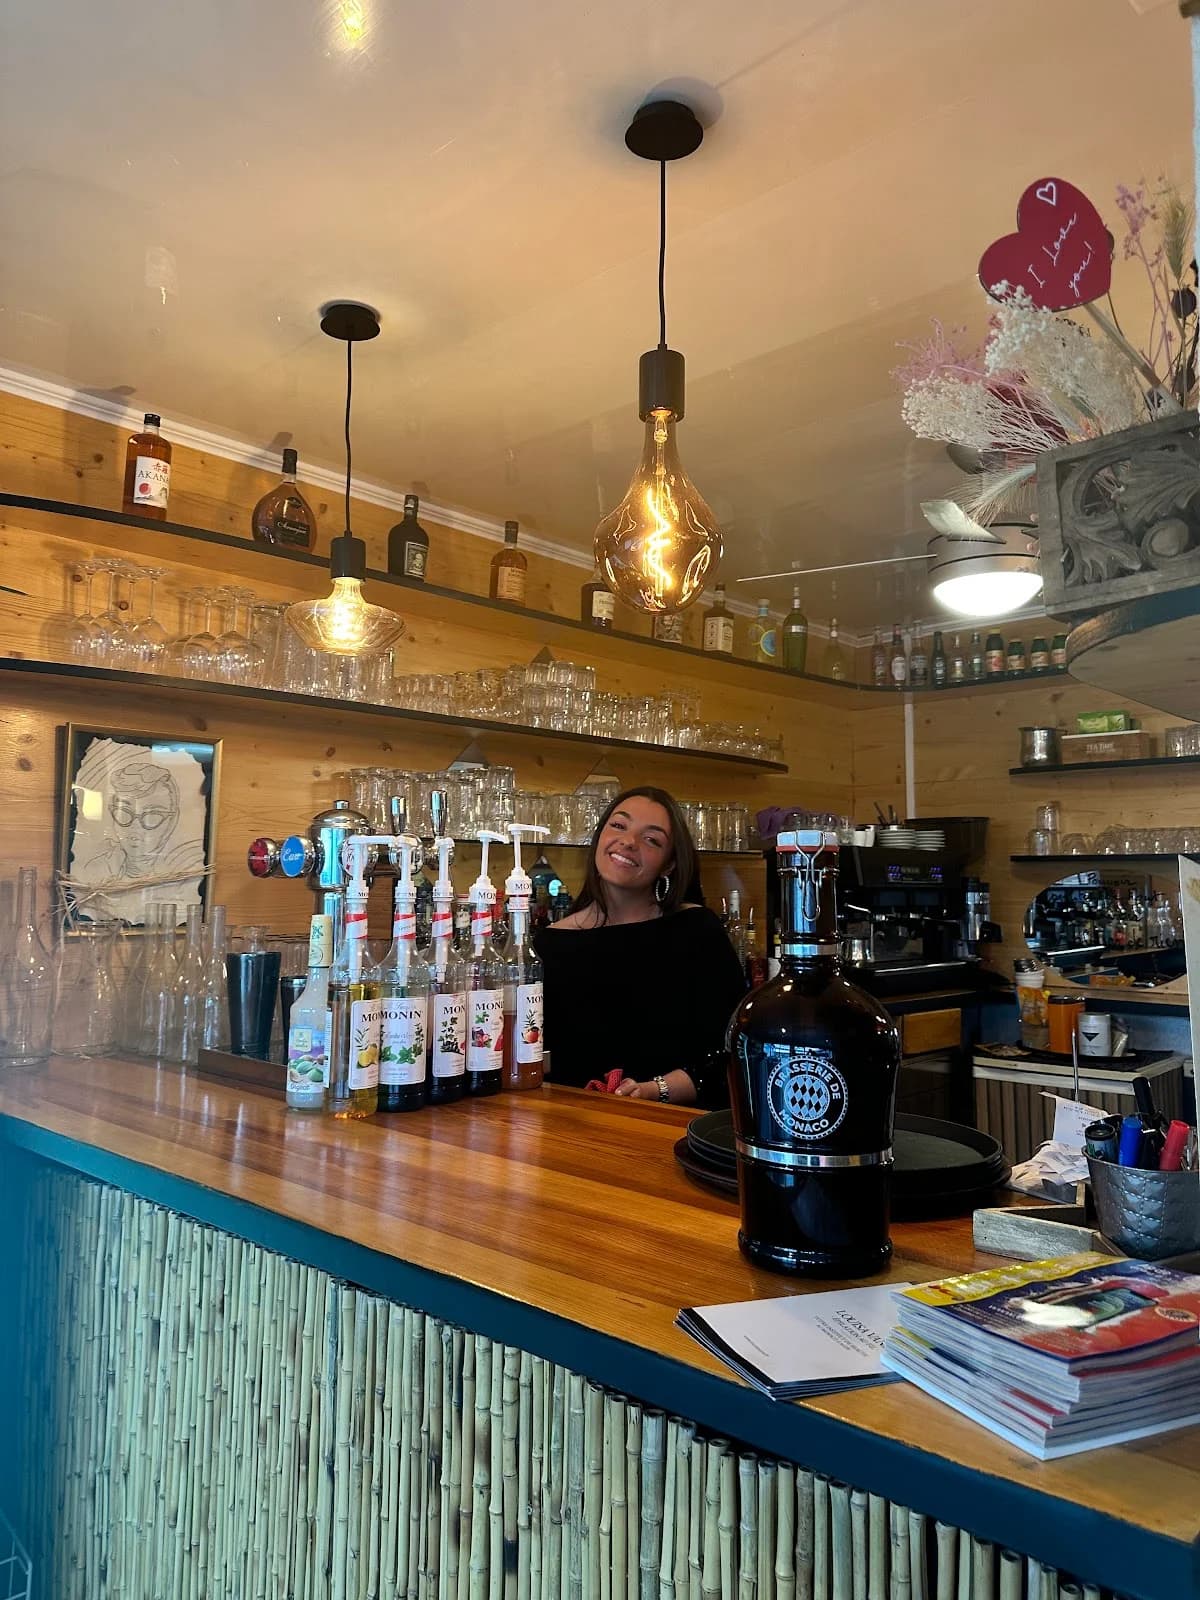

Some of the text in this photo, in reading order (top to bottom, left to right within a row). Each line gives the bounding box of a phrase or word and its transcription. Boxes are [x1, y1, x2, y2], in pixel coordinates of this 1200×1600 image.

[1027, 212, 1078, 289] I Love
[379, 1010, 421, 1020] MONIN
[774, 1062, 841, 1100] BRASSERIE DE
[779, 1109, 829, 1133] MONACO
